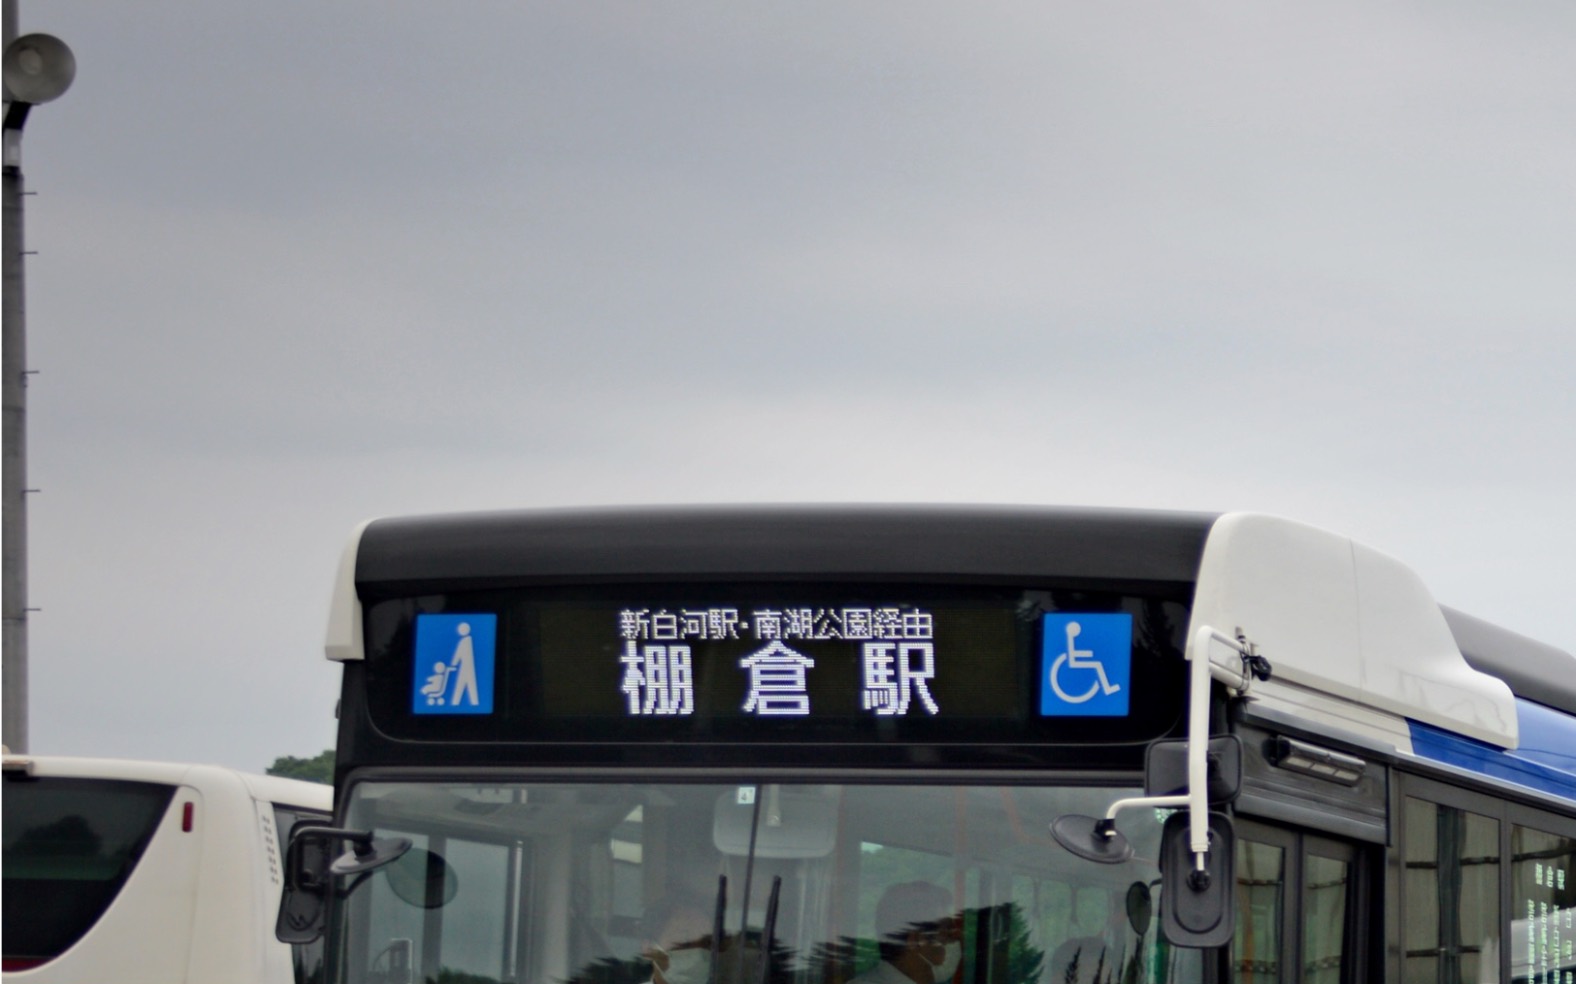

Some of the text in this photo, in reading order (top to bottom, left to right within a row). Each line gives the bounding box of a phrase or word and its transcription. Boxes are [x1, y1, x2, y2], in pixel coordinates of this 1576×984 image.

[620, 608, 934, 640] 新白河駅・南湖公園経由
[620, 640, 939, 715] 棚倉駅
